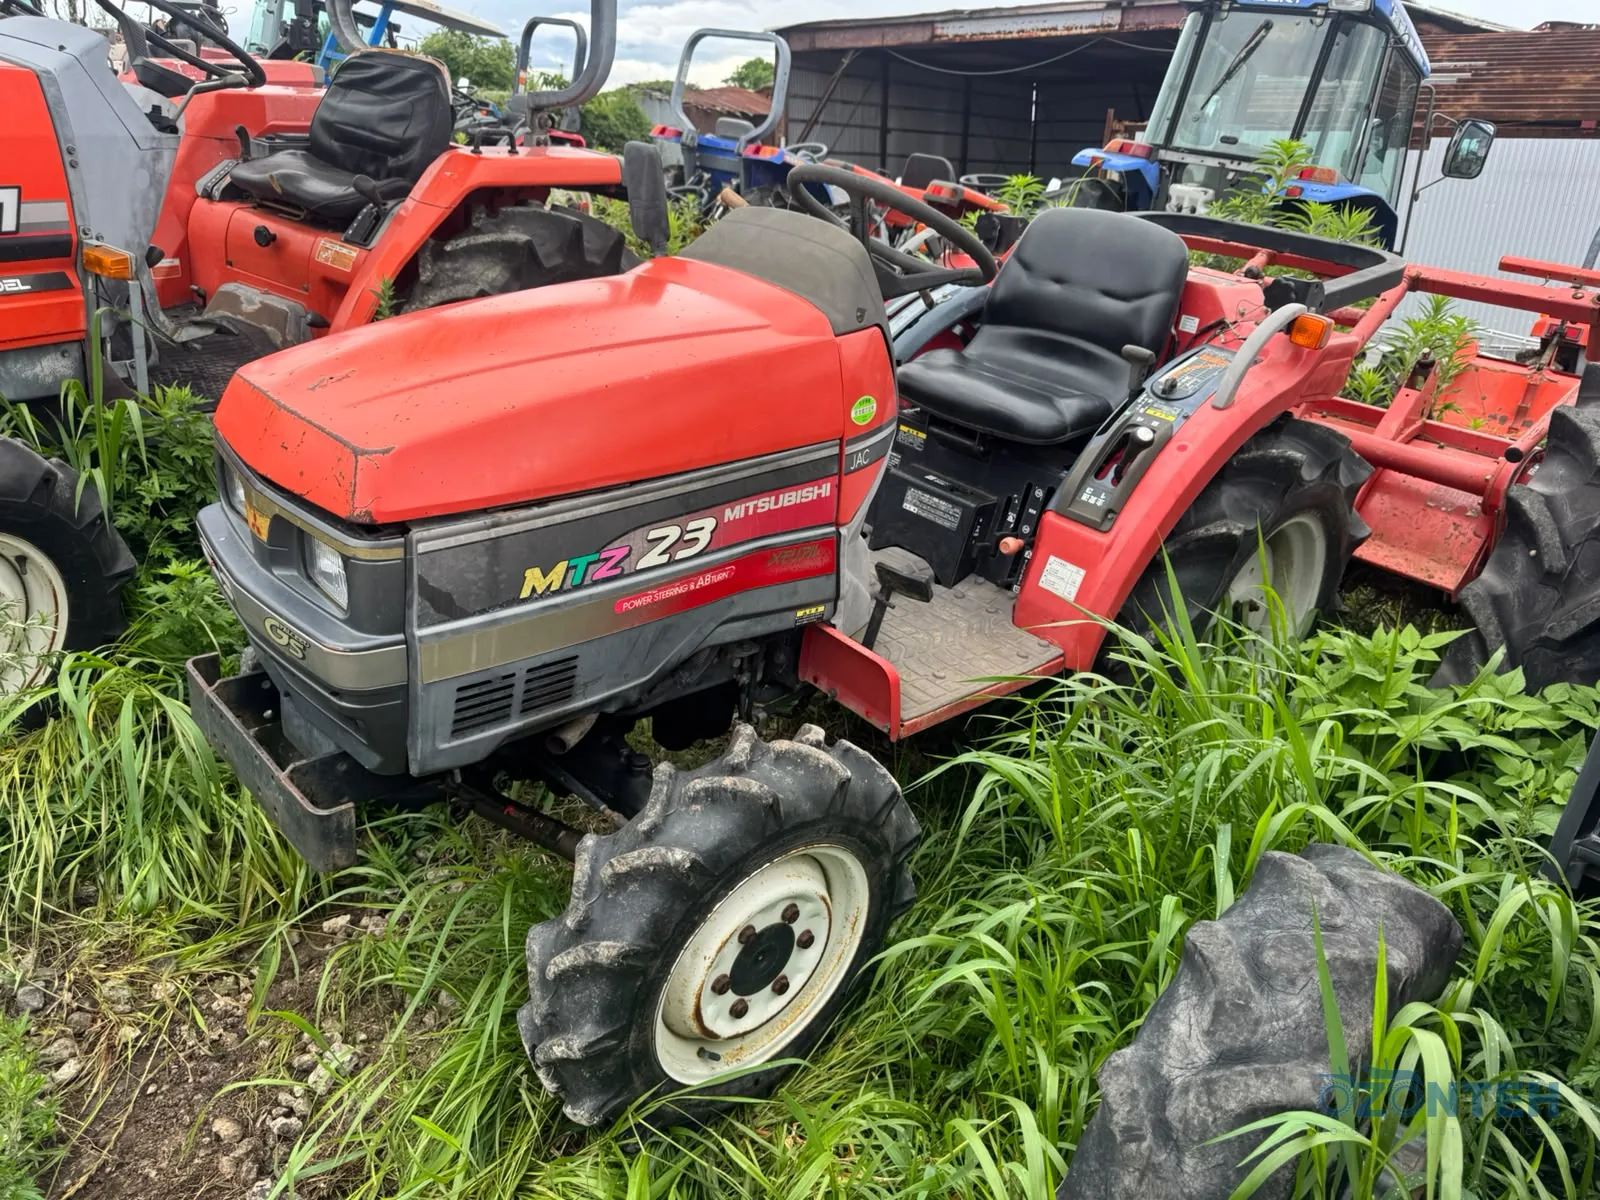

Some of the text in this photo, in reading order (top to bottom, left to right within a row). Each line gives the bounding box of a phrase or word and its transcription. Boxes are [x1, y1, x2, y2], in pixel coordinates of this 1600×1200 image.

[850, 449, 870, 470] JAC
[723, 482, 832, 523] MITSUBISHI
[519, 546, 631, 599] MTZ
[635, 516, 718, 571] 23
[622, 595, 653, 612] POWER
[653, 584, 689, 602] STEERING
